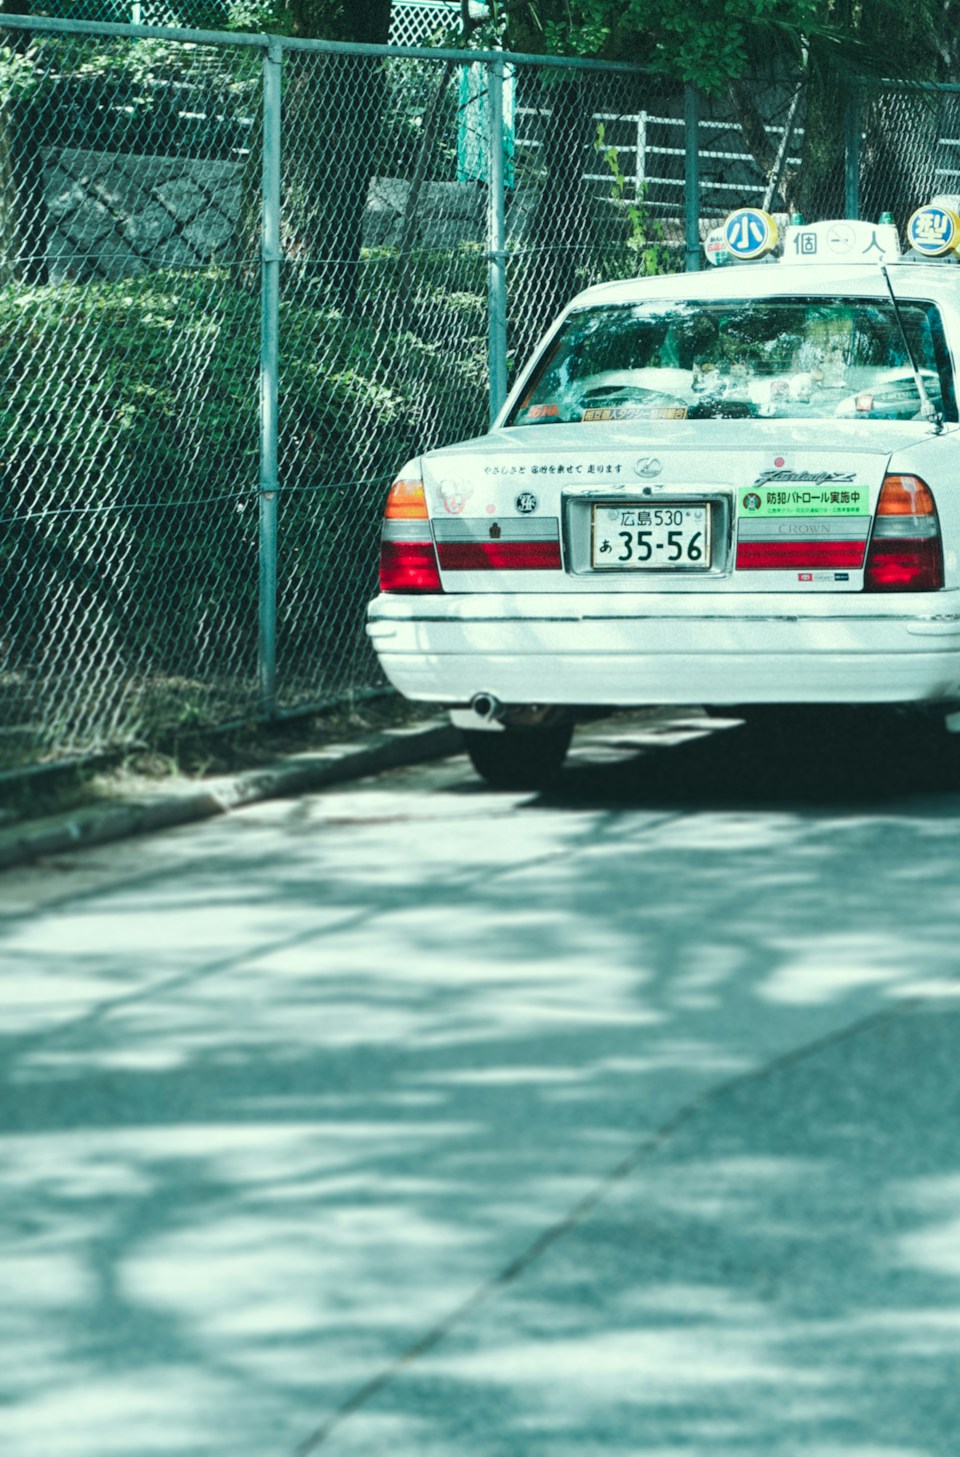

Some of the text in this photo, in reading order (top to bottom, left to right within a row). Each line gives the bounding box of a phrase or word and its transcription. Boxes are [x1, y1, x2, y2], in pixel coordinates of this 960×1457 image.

[728, 215, 763, 250] 小
[793, 231, 818, 255] 個
[861, 230, 887, 255] 人
[914, 213, 948, 247] 型
[766, 491, 860, 505] 防犯パトロール実施中
[778, 524, 831, 534] CROWN
[599, 531, 702, 561] あ 35-56
